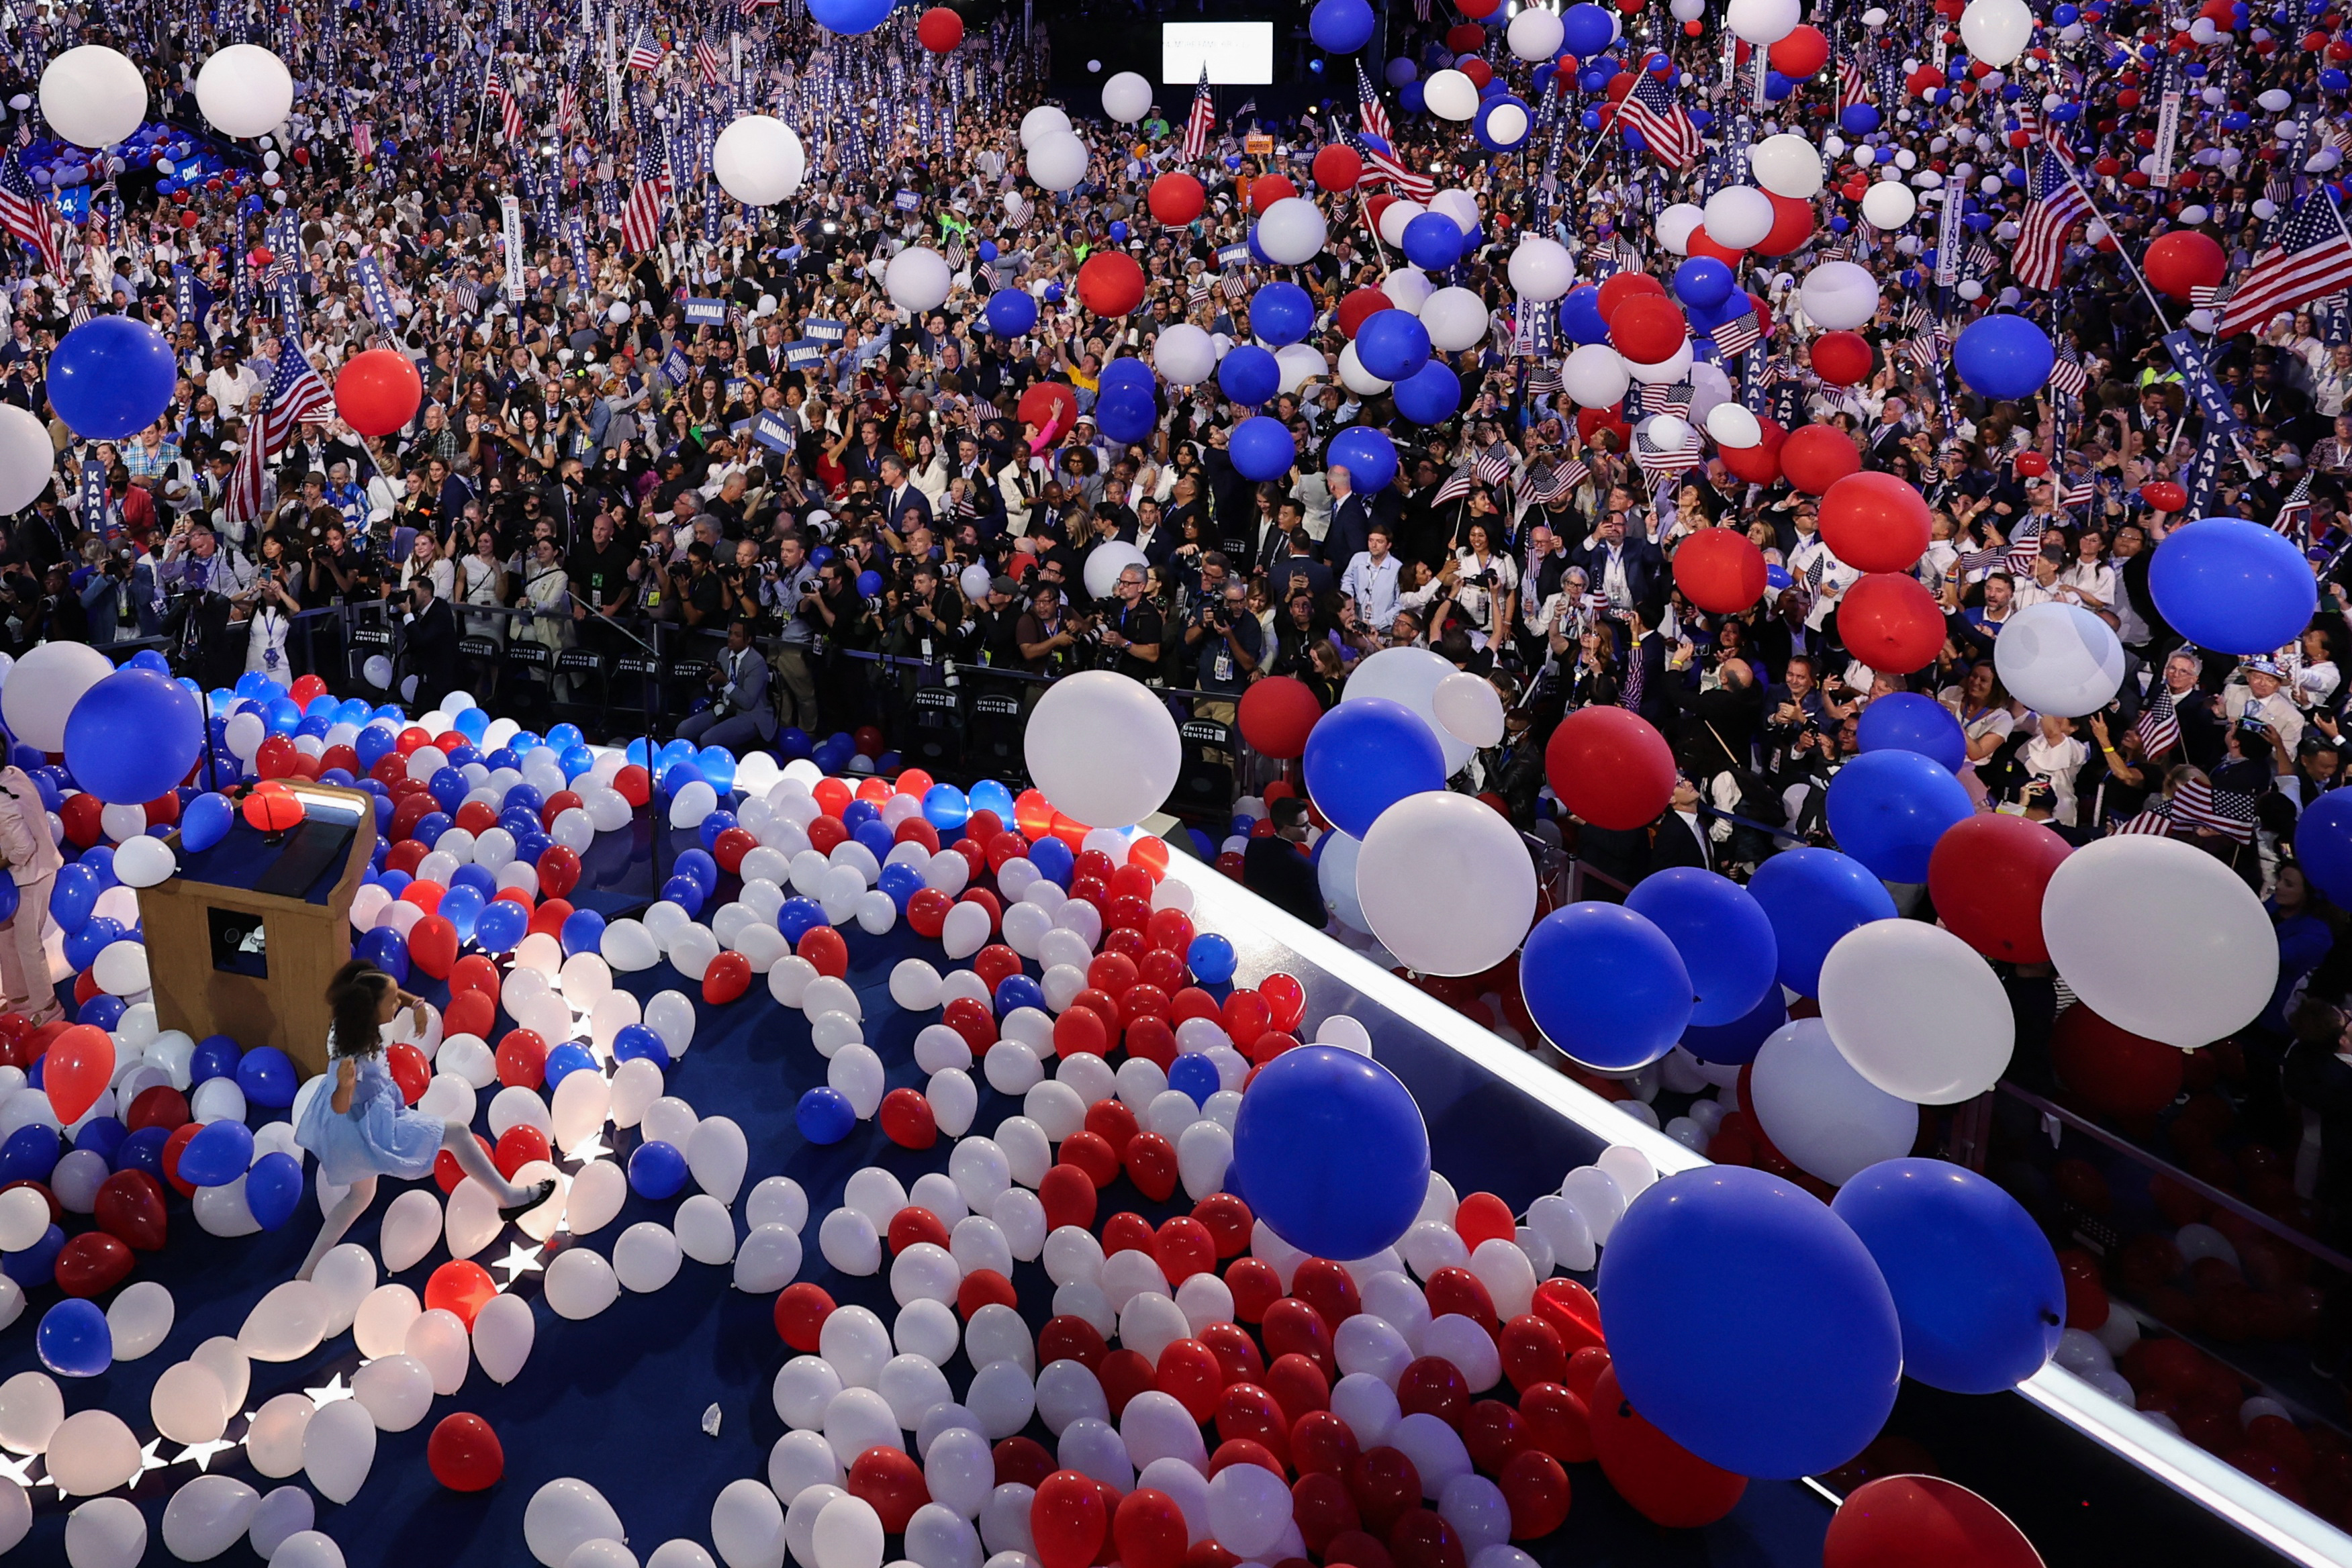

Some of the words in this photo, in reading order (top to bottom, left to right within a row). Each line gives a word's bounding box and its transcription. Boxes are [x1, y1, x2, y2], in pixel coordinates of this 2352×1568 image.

[1726, 34, 1734, 52] NEW
[632, 91, 642, 128] KAMALA
[744, 72, 752, 107] KAMALA
[920, 103, 928, 140] KAMALA
[943, 113, 951, 153] KAMALA
[552, 135, 560, 177] KAMALA
[682, 139, 690, 183] KAMALA
[1550, 122, 1564, 166] KAMALA
[520, 154, 535, 195] KAMALA
[546, 186, 559, 233] KAMALA
[708, 191, 716, 240] KAMALA
[896, 192, 916, 204] HARRIS
[1563, 186, 1573, 231] KAMALA
[509, 209, 520, 285] PENNSYLVANIA
[1945, 190, 1959, 269] ILLINOIS
[573, 230, 587, 283] KAMALA
[1219, 247, 1248, 263] KAMALA
[237, 258, 246, 311] KAMALA
[363, 264, 393, 322] KAMALA
[282, 283, 296, 335] KAMAL
[688, 304, 723, 318] KAMALA
[806, 325, 843, 340] KAMALA
[668, 365, 684, 383] WALZ
[788, 346, 820, 362] KAMALA
[759, 417, 790, 446] KAMALA
[2188, 432, 2220, 520] KAMALA
[88, 471, 101, 533] KAMAL
[1183, 725, 1214, 734] UNITED
[1183, 731, 1213, 740] CENTER
